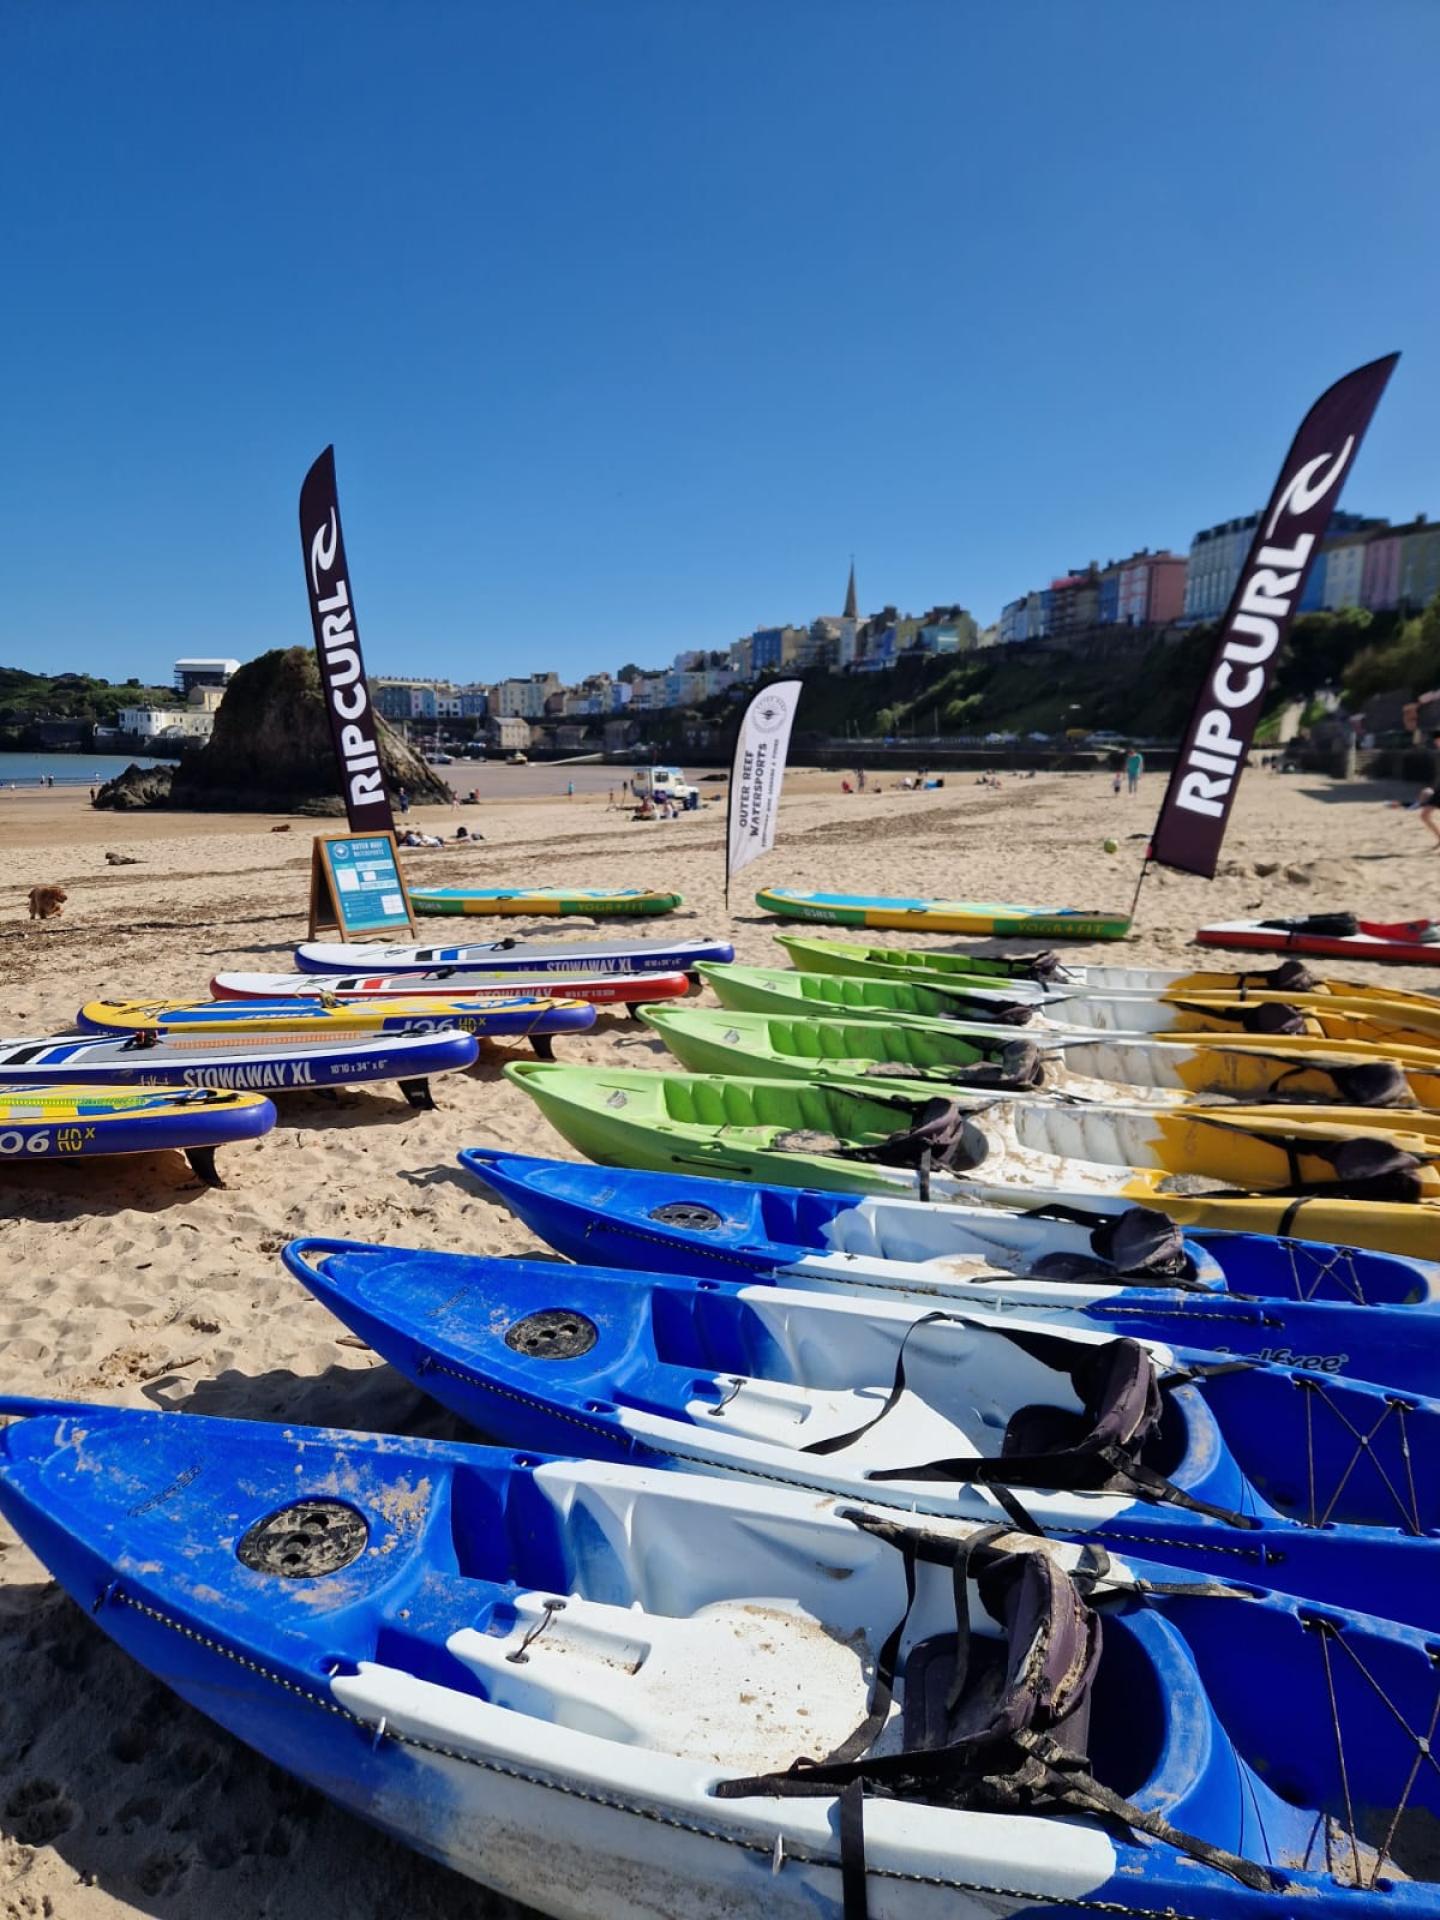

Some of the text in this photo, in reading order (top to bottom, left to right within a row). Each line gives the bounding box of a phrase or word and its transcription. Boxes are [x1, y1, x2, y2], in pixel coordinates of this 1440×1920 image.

[739, 750, 754, 828] OUTER REEF
[750, 743, 767, 837] WATERSPORTS
[546, 959, 616, 972] STOWAWAY
[618, 958, 632, 971] XL
[183, 1063, 285, 1088] STOWAWAY
[291, 1062, 316, 1084] XL
